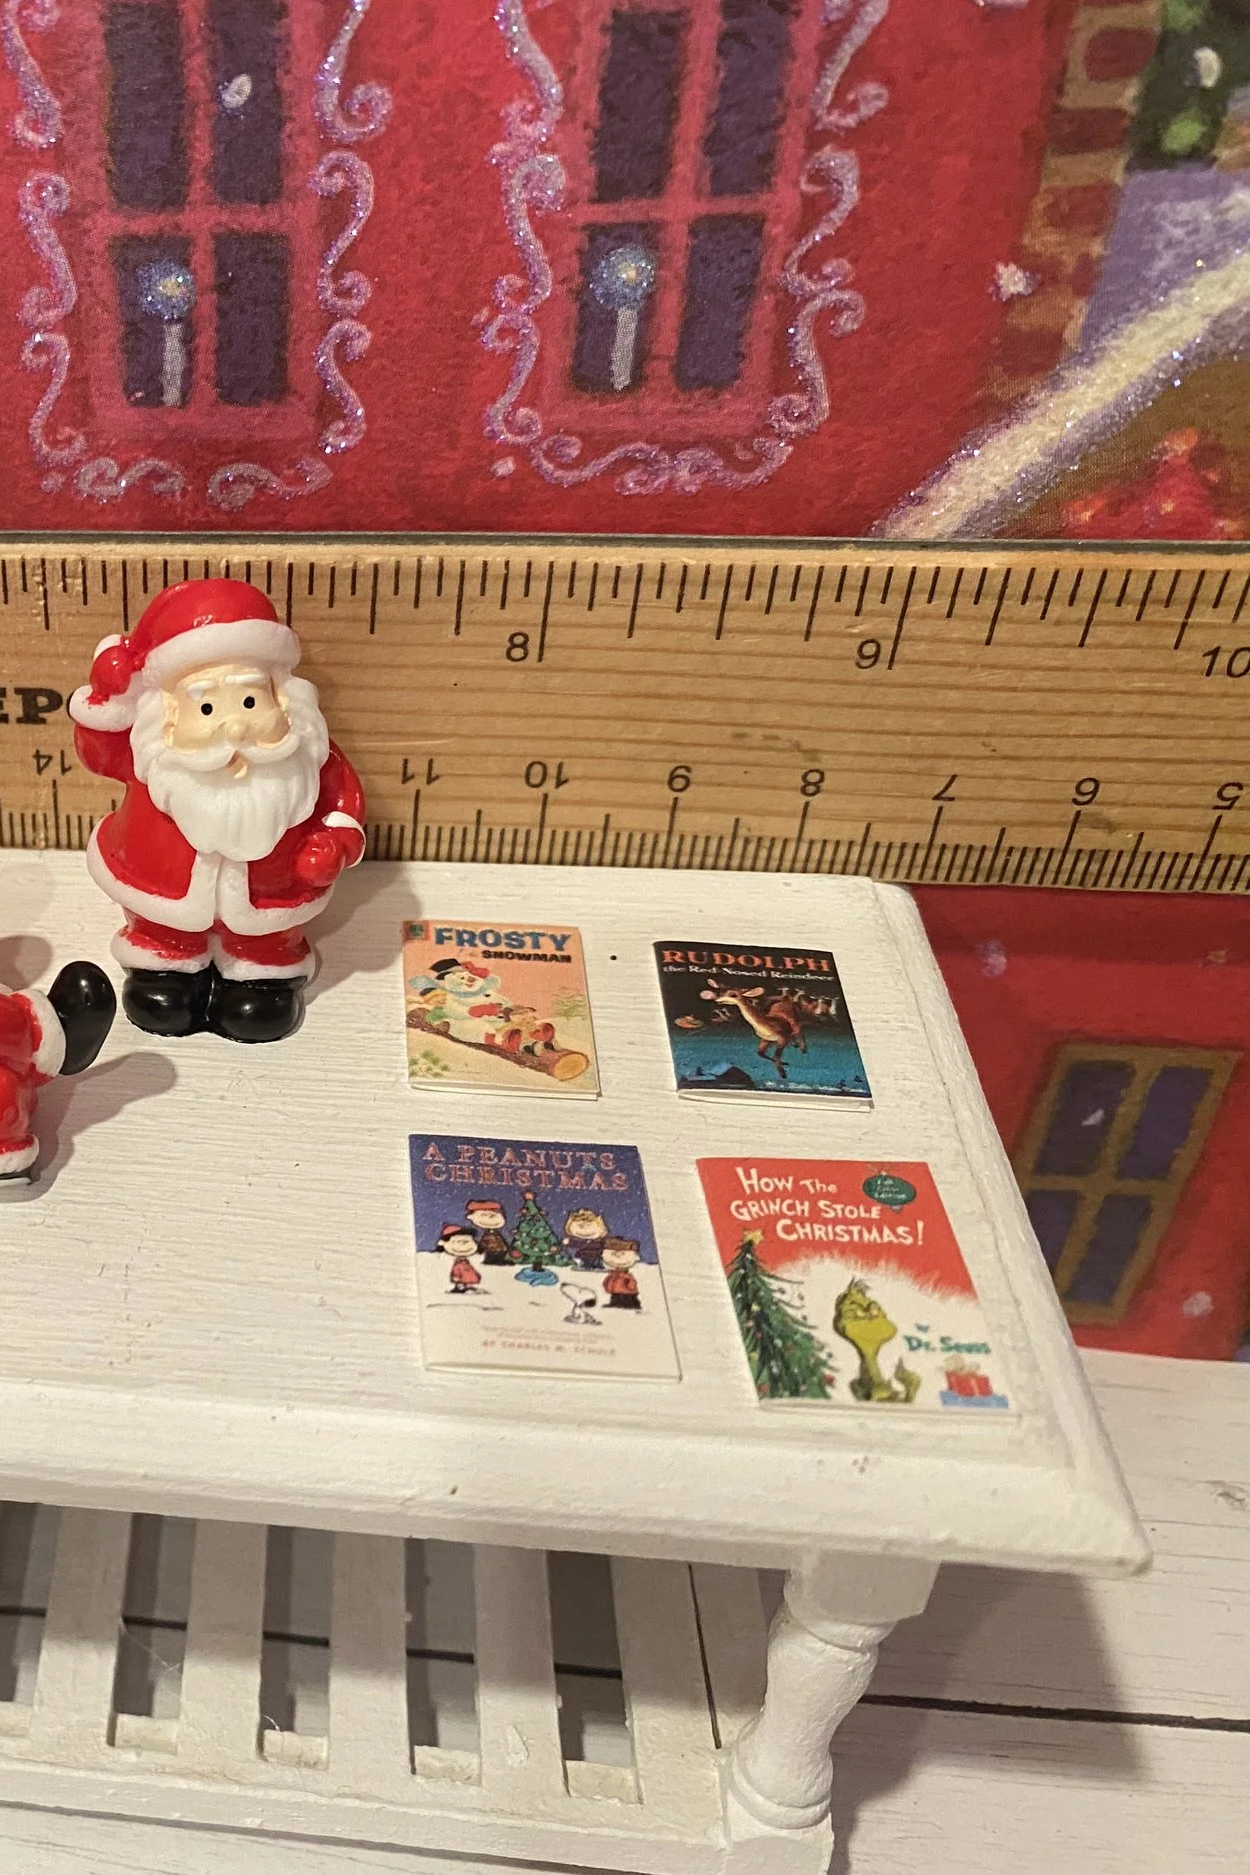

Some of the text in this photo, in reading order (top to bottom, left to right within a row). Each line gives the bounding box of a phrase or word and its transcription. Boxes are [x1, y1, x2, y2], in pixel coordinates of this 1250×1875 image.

[505, 631, 530, 662] 8
[855, 638, 881, 669] 9
[1201, 646, 1250, 678] 10
[32, 748, 73, 775] 14
[401, 758, 440, 785] 11
[524, 760, 570, 789] 10
[800, 769, 825, 797] 8
[932, 774, 958, 802] 7
[1212, 781, 1244, 811] 5
[434, 927, 571, 952] FROSTY
[481, 949, 573, 963] SNOWMAN
[661, 950, 831, 973] RUDOLPH
[662, 965, 685, 973] the
[770, 970, 835, 982] Reindeer
[422, 1142, 617, 1171] A PEANUTS
[424, 1163, 629, 1191] CHRISTMAS
[729, 1199, 883, 1222] GRINCH STOLE
[775, 1218, 925, 1246] CHRISTMAS!
